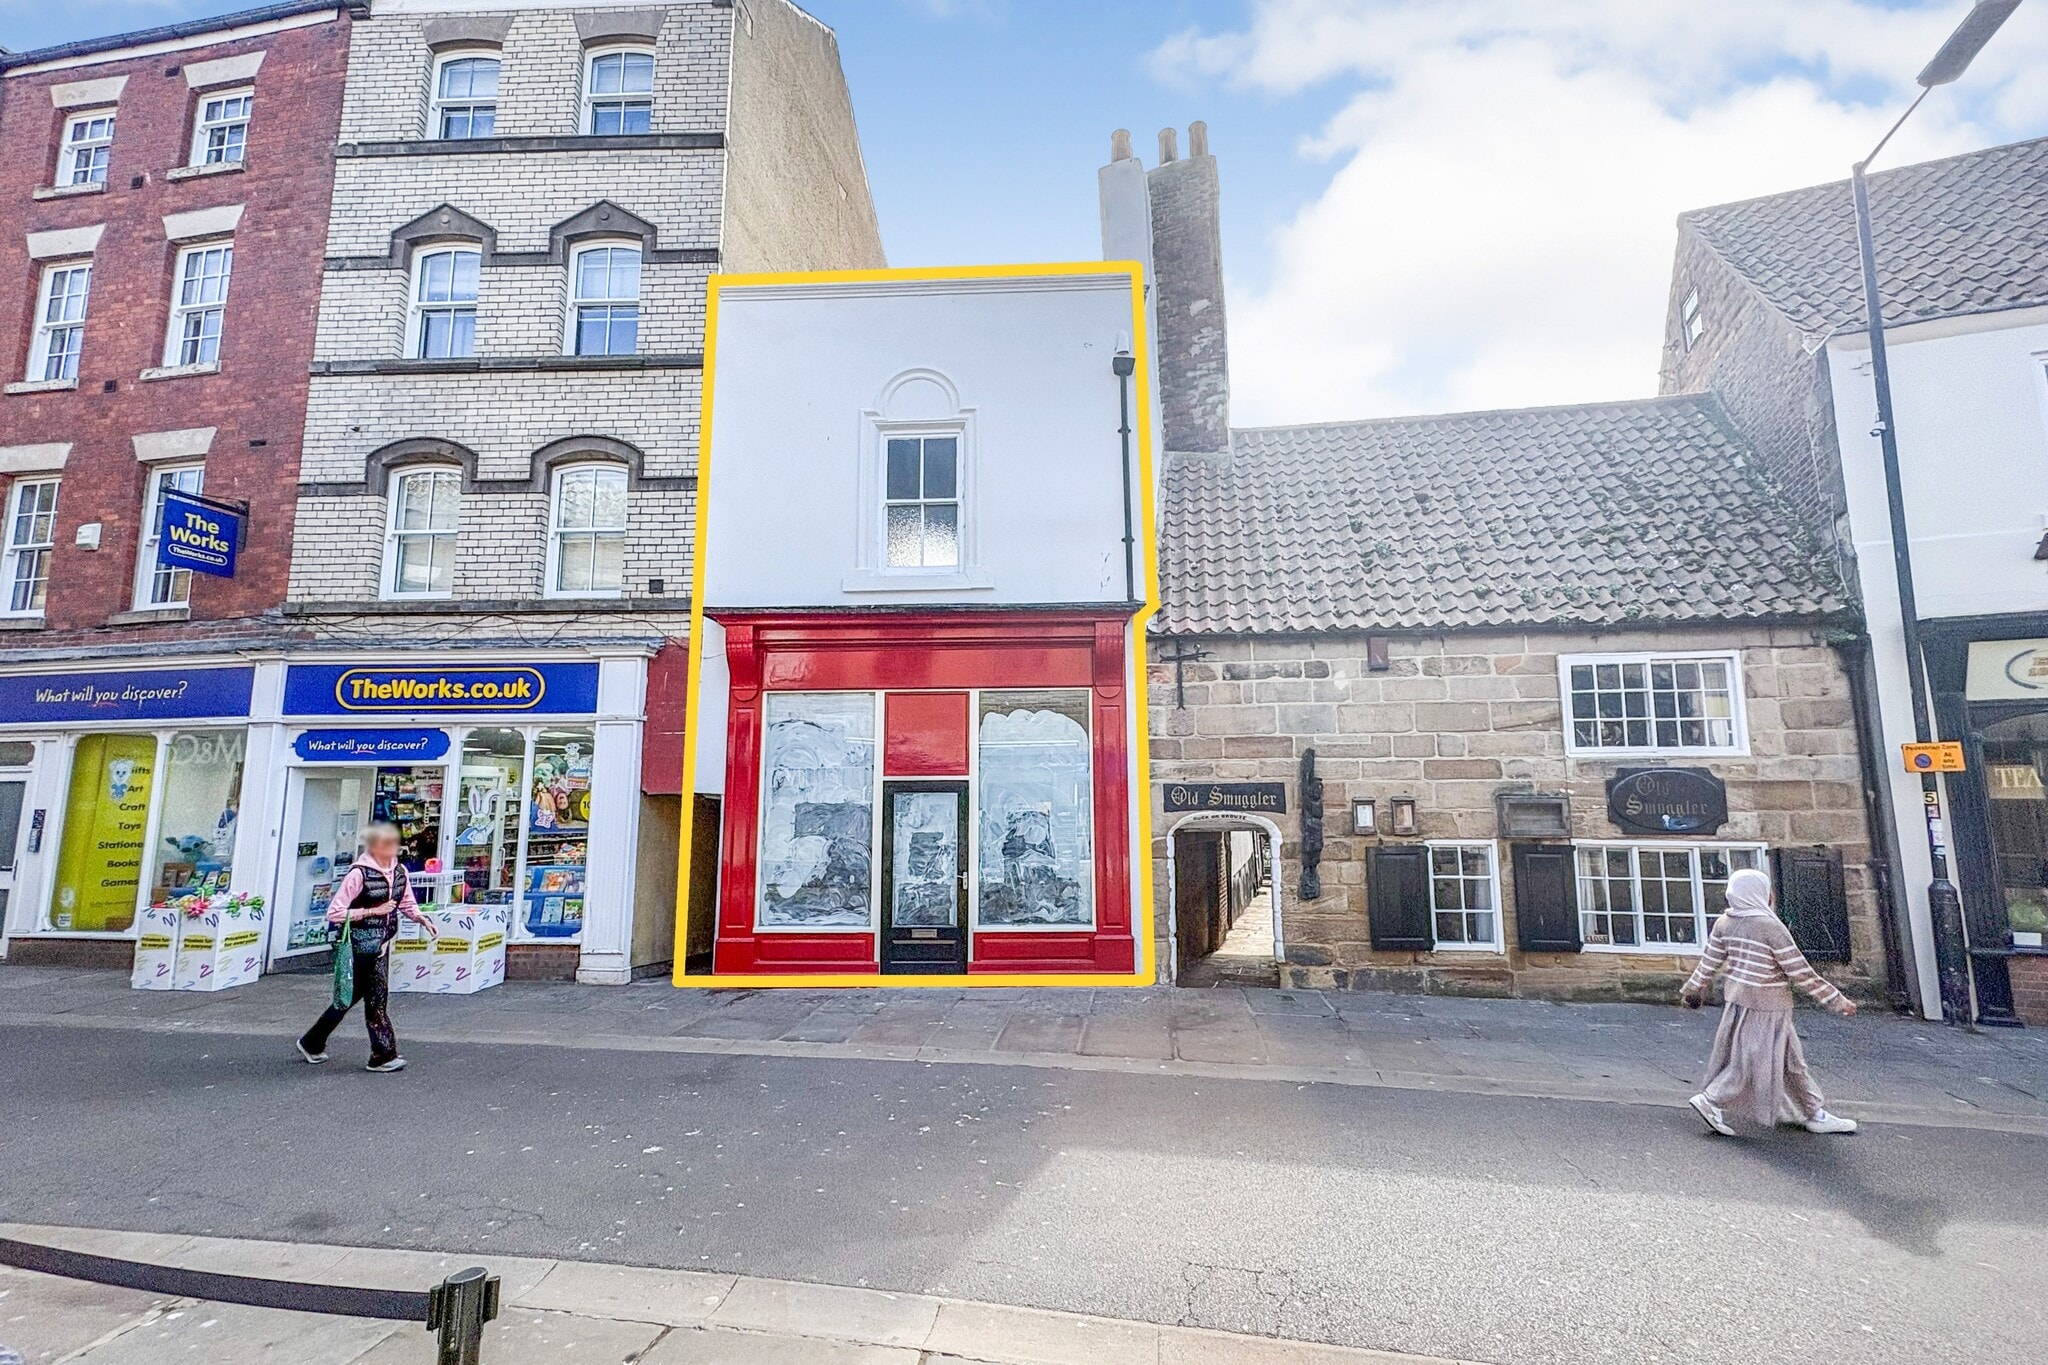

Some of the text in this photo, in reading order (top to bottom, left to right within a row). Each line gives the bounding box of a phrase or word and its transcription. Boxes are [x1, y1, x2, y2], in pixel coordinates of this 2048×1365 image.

[185, 512, 219, 534] The
[170, 525, 229, 552] Works
[172, 546, 224, 563] TheWorks.co.uk
[36, 680, 188, 706] What will you discover?
[350, 677, 531, 699] TheWorks.co.uk
[308, 737, 429, 754] What will you discover?
[1995, 767, 2045, 788] TEA
[126, 784, 144, 793] Art
[1171, 785, 1277, 808] Old Smuggler
[1626, 794, 1708, 817] Smuggler
[1924, 792, 1935, 803] 5
[119, 803, 146, 811] Craft
[118, 822, 141, 831] Toys
[107, 859, 140, 868] Books
[101, 878, 139, 887] Games
